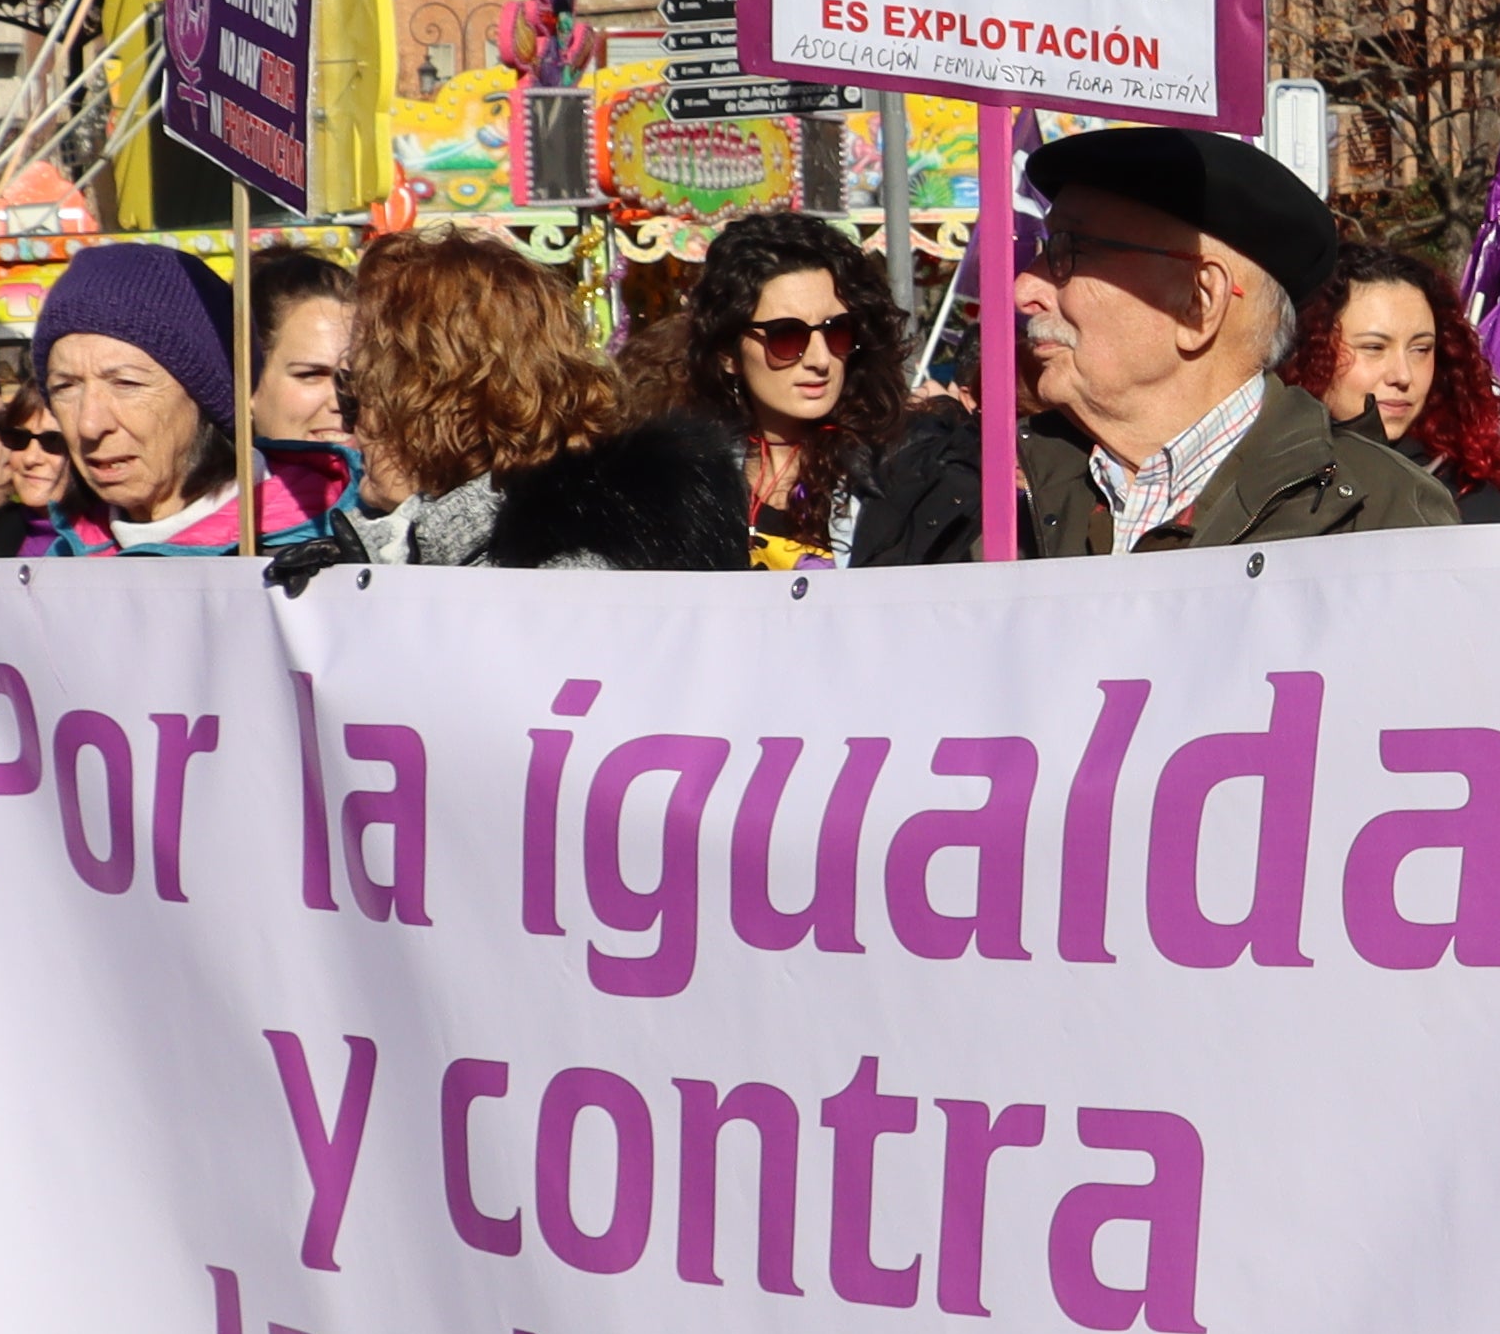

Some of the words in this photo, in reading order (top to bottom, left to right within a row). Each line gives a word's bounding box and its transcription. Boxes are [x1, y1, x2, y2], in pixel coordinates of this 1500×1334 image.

[218, 26, 235, 78] NO
[235, 36, 262, 91] HAY
[260, 48, 296, 114] TRATA
[790, 34, 919, 71] ASOCIACIÓN
[933, 55, 1047, 89] FEMINISTA
[1067, 70, 1114, 96] FLORA
[1120, 73, 1210, 105] TRISTÁN
[883, 5, 1160, 70] EXPLOTACIÓN
[209, 90, 223, 140] NI
[223, 97, 305, 191] PROSTITUCIÓN
[293, 671, 434, 927] la
[262, 1028, 380, 1273] y
